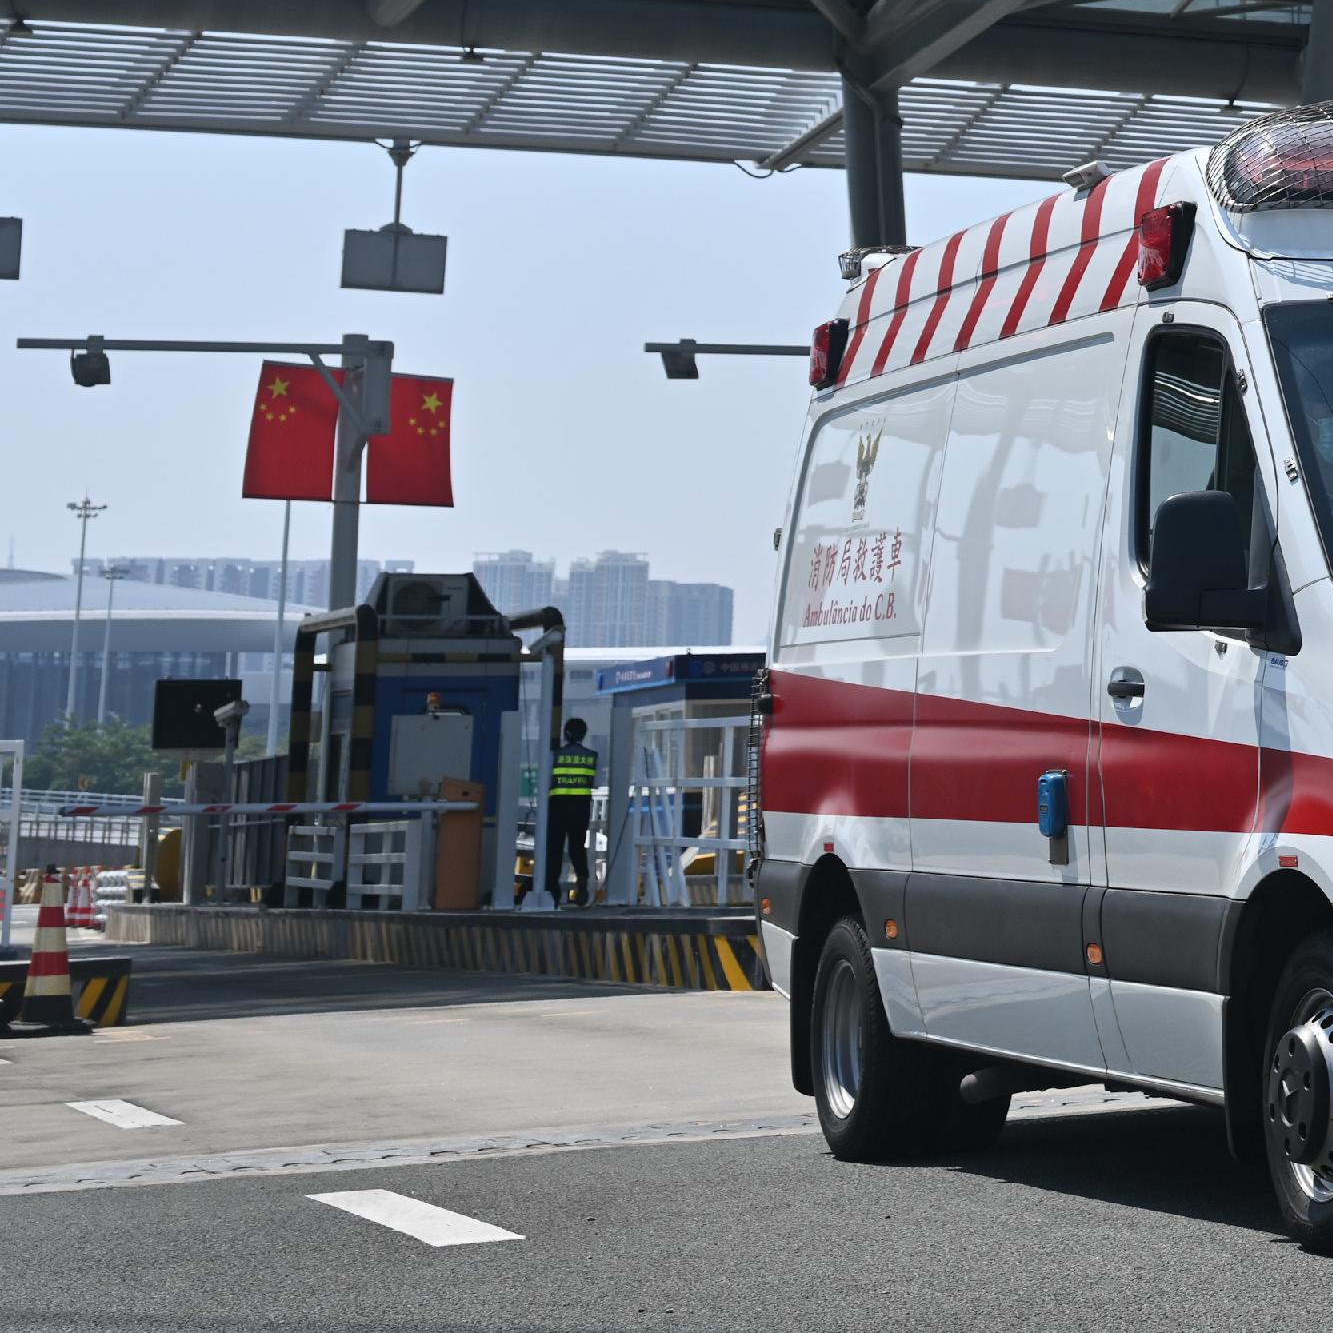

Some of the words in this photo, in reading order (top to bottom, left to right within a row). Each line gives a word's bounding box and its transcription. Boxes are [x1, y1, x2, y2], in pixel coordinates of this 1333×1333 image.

[808, 528, 902, 592] 消防局救護車
[803, 599, 857, 628] Ambulância
[874, 592, 896, 621] C.B.
